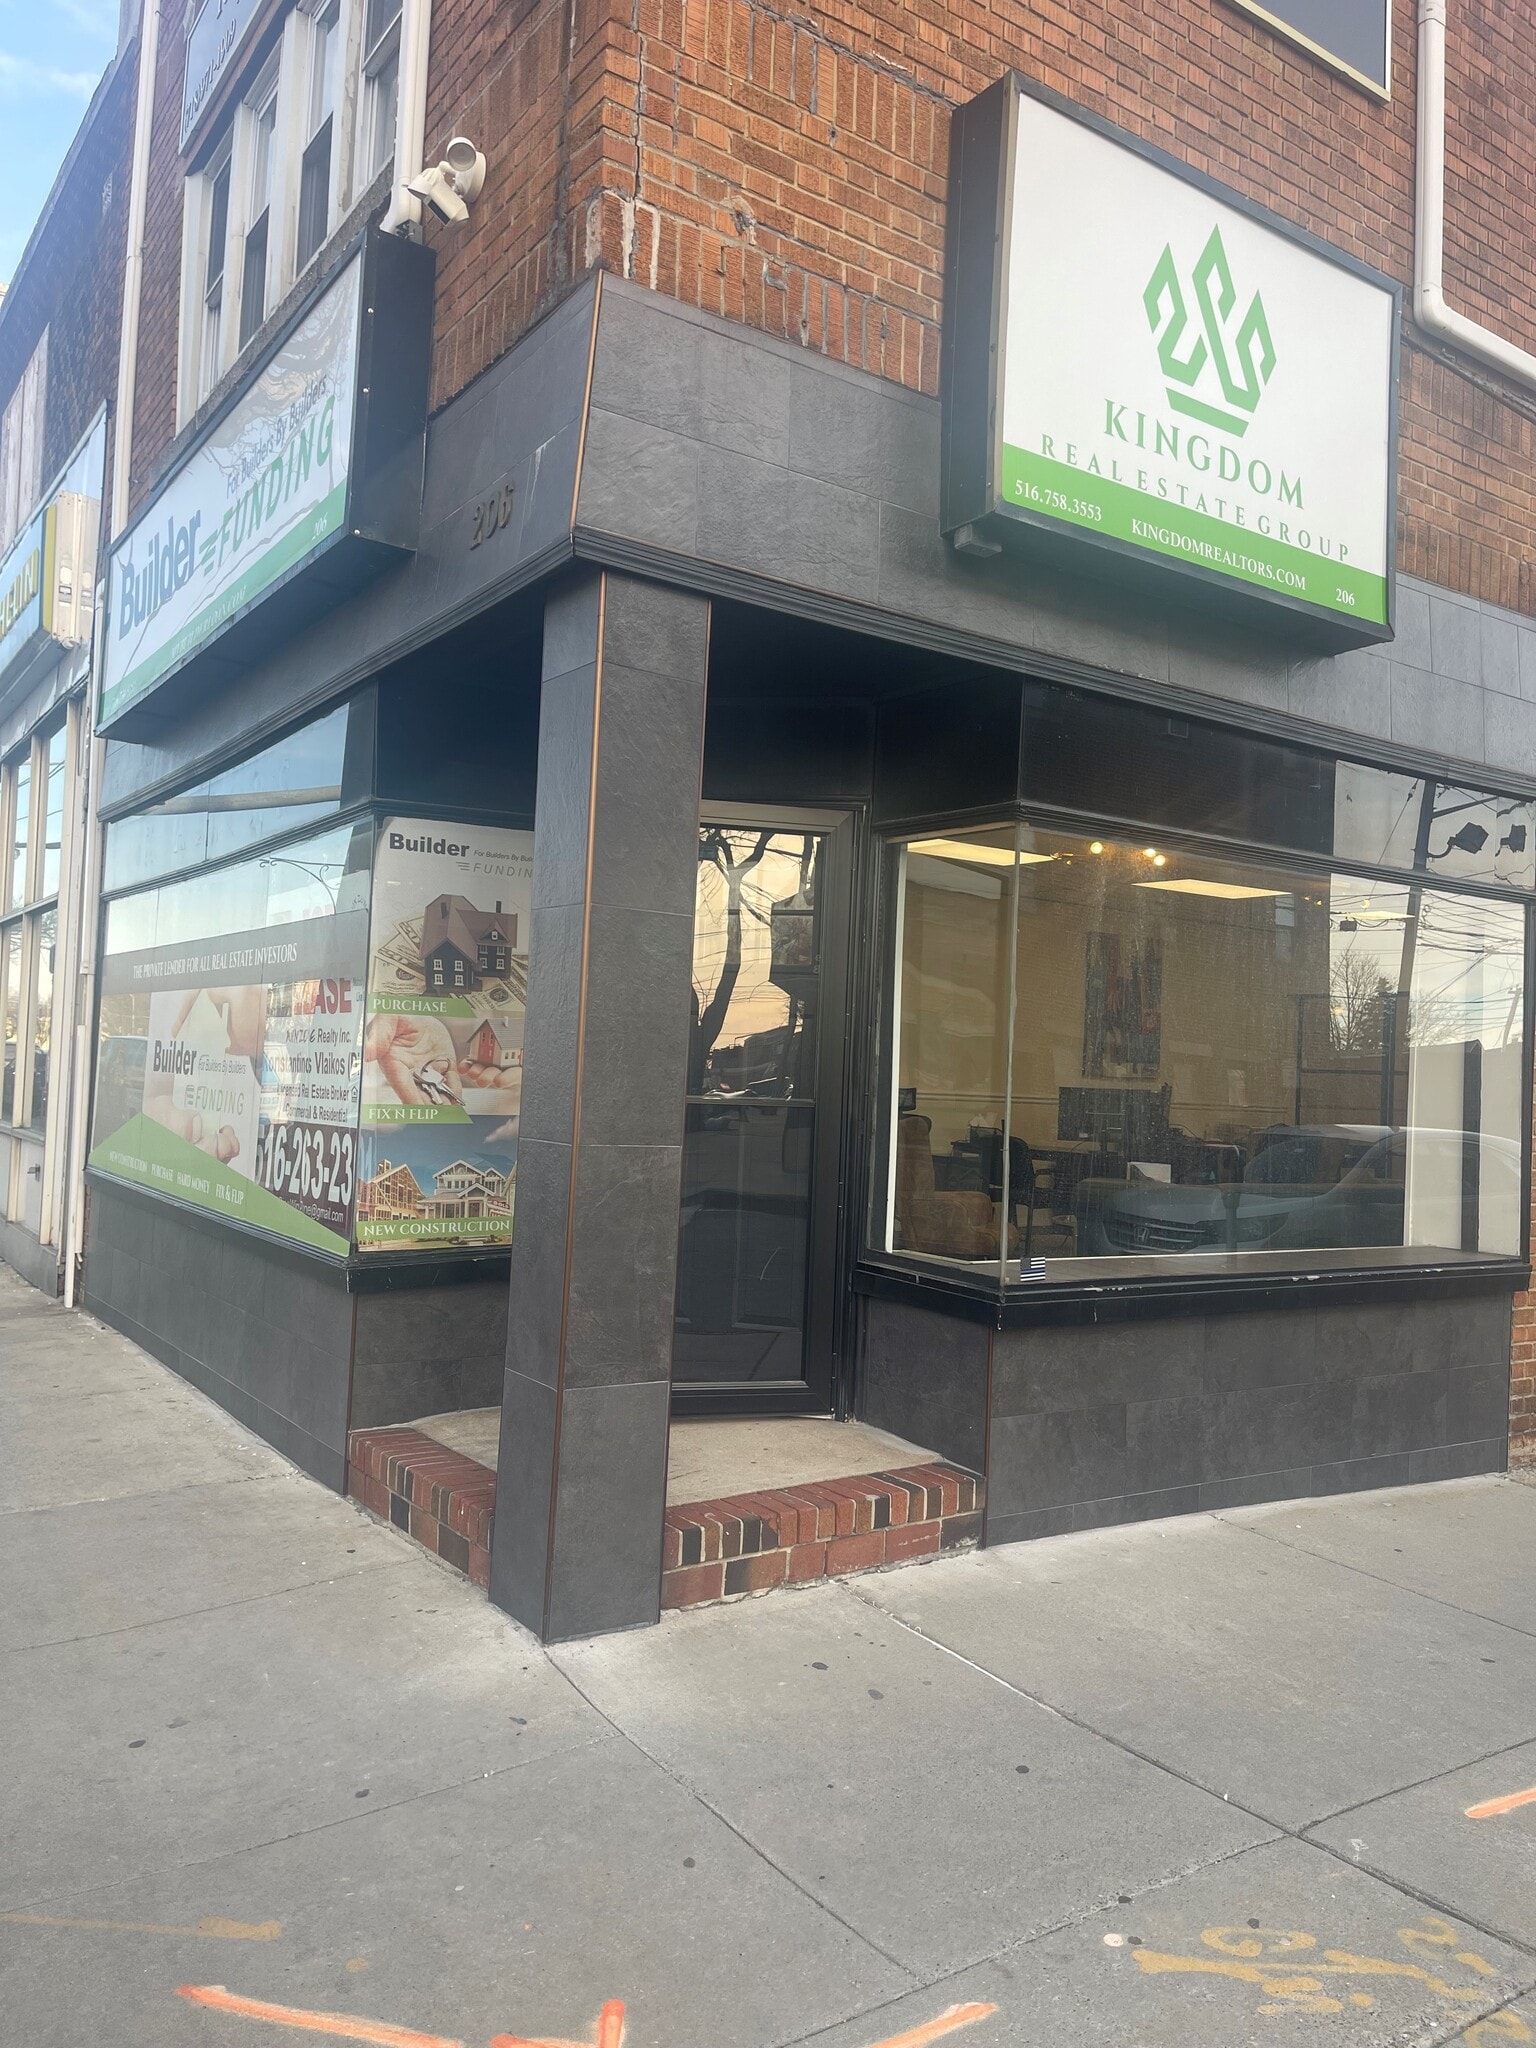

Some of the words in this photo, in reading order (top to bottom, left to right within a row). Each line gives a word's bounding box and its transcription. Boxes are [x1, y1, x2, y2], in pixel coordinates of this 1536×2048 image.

[1103, 398, 1305, 510] KINGDOM
[217, 394, 336, 568] FUNDING
[1041, 433, 1123, 483] REAL
[1137, 469, 1247, 526] ESTATE
[1258, 515, 1350, 563] GROUP
[469, 480, 515, 551] 206
[1014, 480, 1103, 522] 516.758.3553
[1131, 518, 1307, 591] KINGDOMREALTORS.COM
[1335, 588, 1356, 607] 206
[118, 509, 201, 641] Builder
[389, 832, 470, 858] Builder
[474, 849, 485, 857] For
[485, 850, 510, 860] Builders
[511, 853, 520, 862] By
[164, 959, 186, 976] LENDER
[186, 957, 199, 974] FOR
[199, 955, 211, 972] ALL
[211, 953, 228, 970] REAL
[228, 949, 254, 969] ESTATE
[254, 943, 298, 966] INVESTORS
[373, 998, 448, 1013] PURCHASE
[317, 1027, 339, 1047] Realty
[339, 1028, 352, 1044] Inc.
[153, 1040, 197, 1076] Builder
[314, 1051, 346, 1076] Vlaikos
[194, 1085, 245, 1116] FUNDING
[311, 1084, 330, 1100] Estate
[369, 1108, 391, 1120] FIX
[395, 1108, 406, 1120] N
[409, 1108, 439, 1120] FLIP
[364, 1224, 397, 1237] NEW
[399, 1220, 511, 1236] CONSTRUCTION
